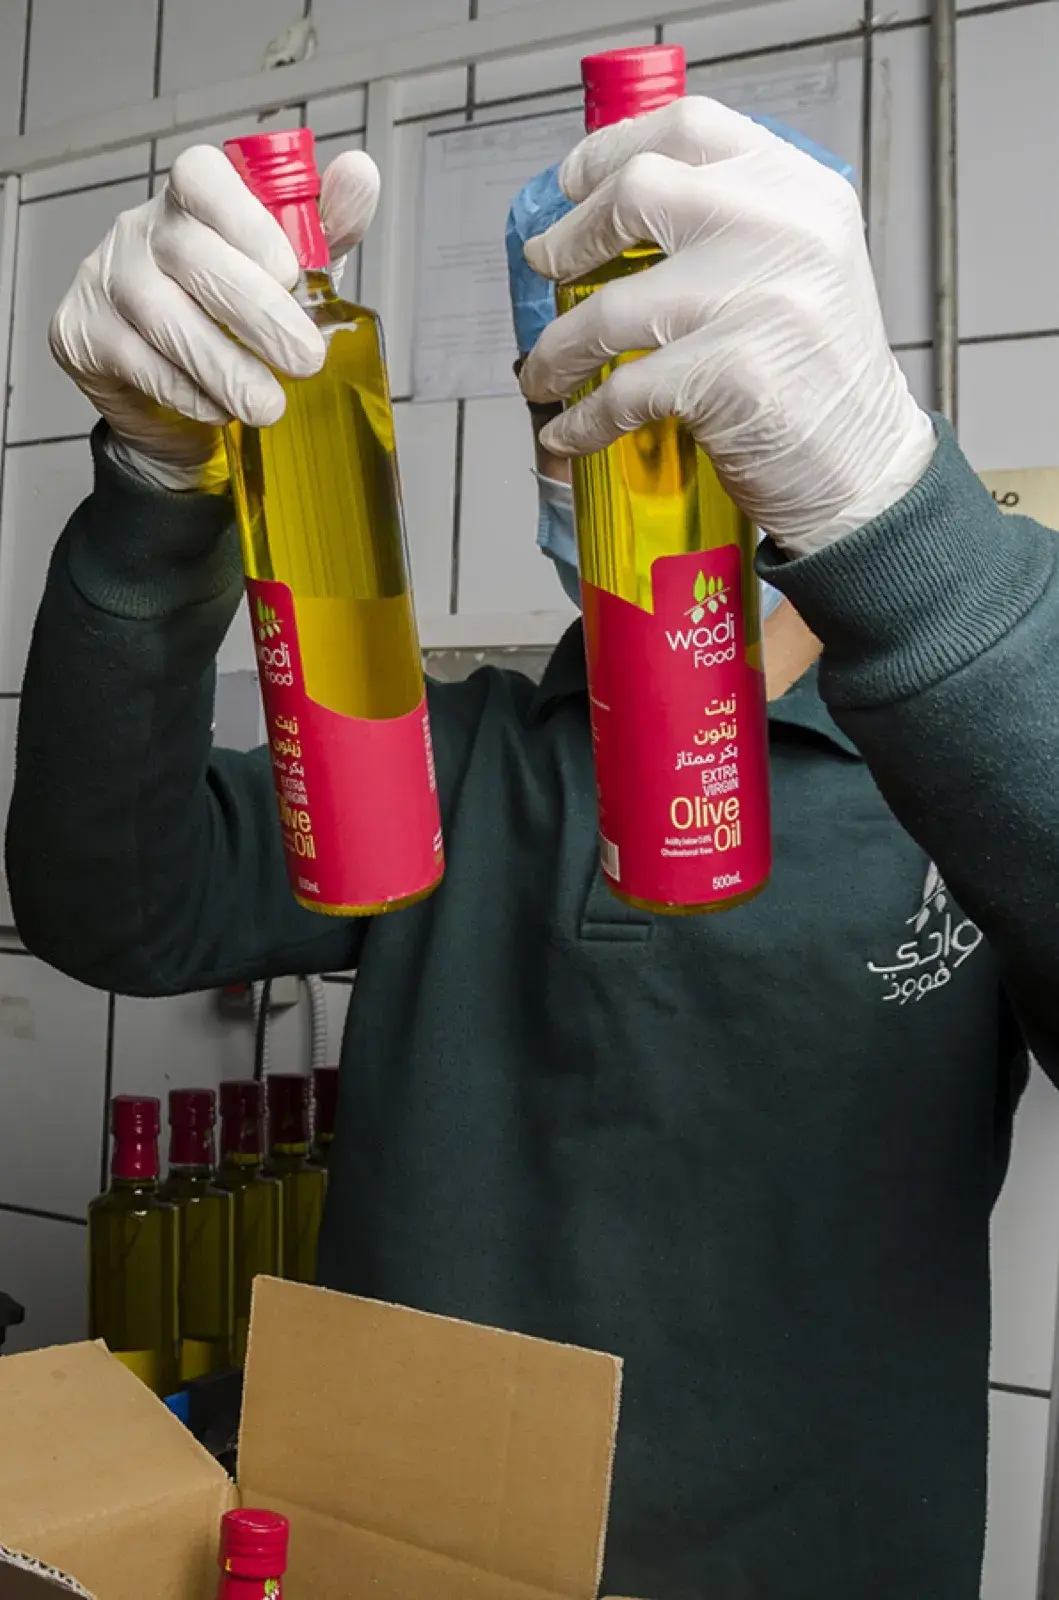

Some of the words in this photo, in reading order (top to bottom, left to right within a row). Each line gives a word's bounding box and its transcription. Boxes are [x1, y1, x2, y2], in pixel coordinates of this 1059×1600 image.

[665, 612, 735, 651] wadi
[261, 641, 291, 668] adi
[694, 642, 737, 669] Food
[704, 692, 737, 716] زيت
[693, 717, 738, 746] زيتون
[674, 749, 715, 771] ممتاز
[719, 742, 739, 764] بكر
[701, 762, 739, 784] EXTRA
[670, 795, 740, 831] Olive
[294, 831, 317, 860] Oil
[714, 819, 742, 853] Oil
[867, 912, 984, 979] وادي
